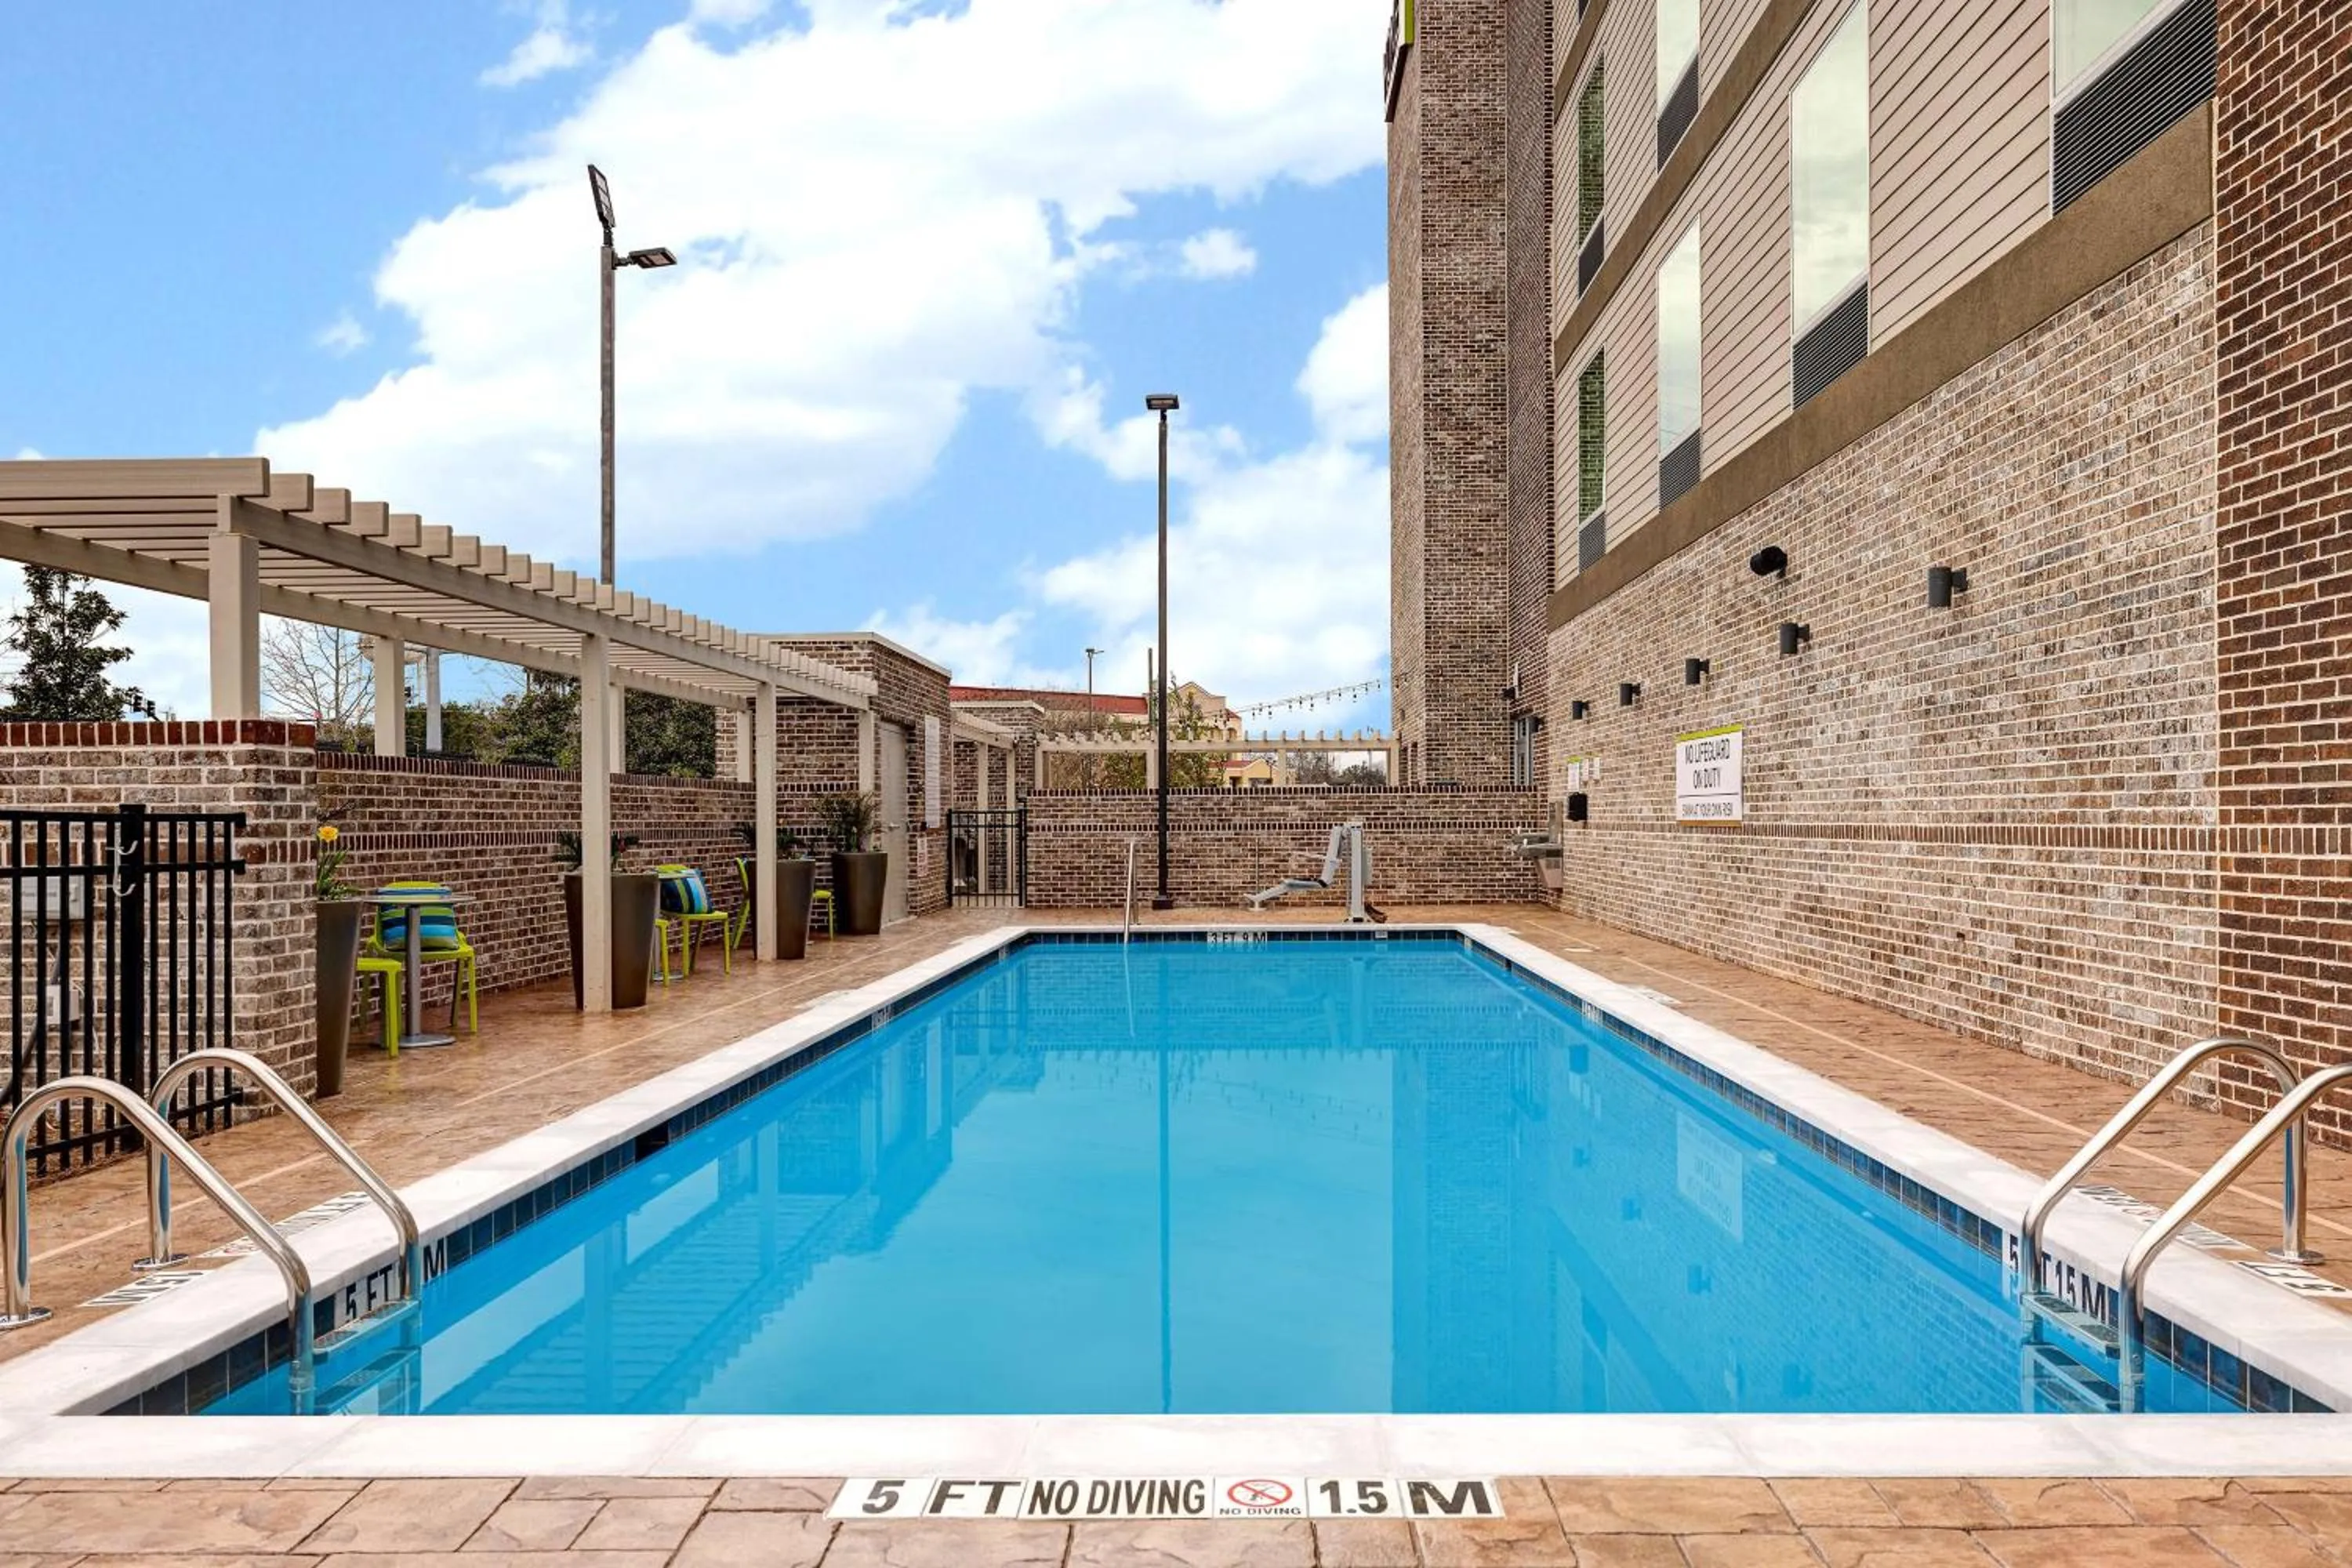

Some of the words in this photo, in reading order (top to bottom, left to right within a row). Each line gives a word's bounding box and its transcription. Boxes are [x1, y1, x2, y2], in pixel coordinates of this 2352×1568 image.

[367, 1262, 393, 1311] FT
[423, 1236, 445, 1284] M
[2009, 1233, 2019, 1275] 5
[2082, 1273, 2107, 1324] M
[862, 1479, 906, 1514] 5
[929, 1479, 1022, 1515] FT
[1028, 1479, 1080, 1515] NO
[1087, 1479, 1206, 1515] DIVING
[1319, 1481, 1388, 1515] 1.5
[1407, 1481, 1494, 1515] M
[1219, 1507, 1242, 1515] NO
[1247, 1507, 1302, 1515] DIVING
